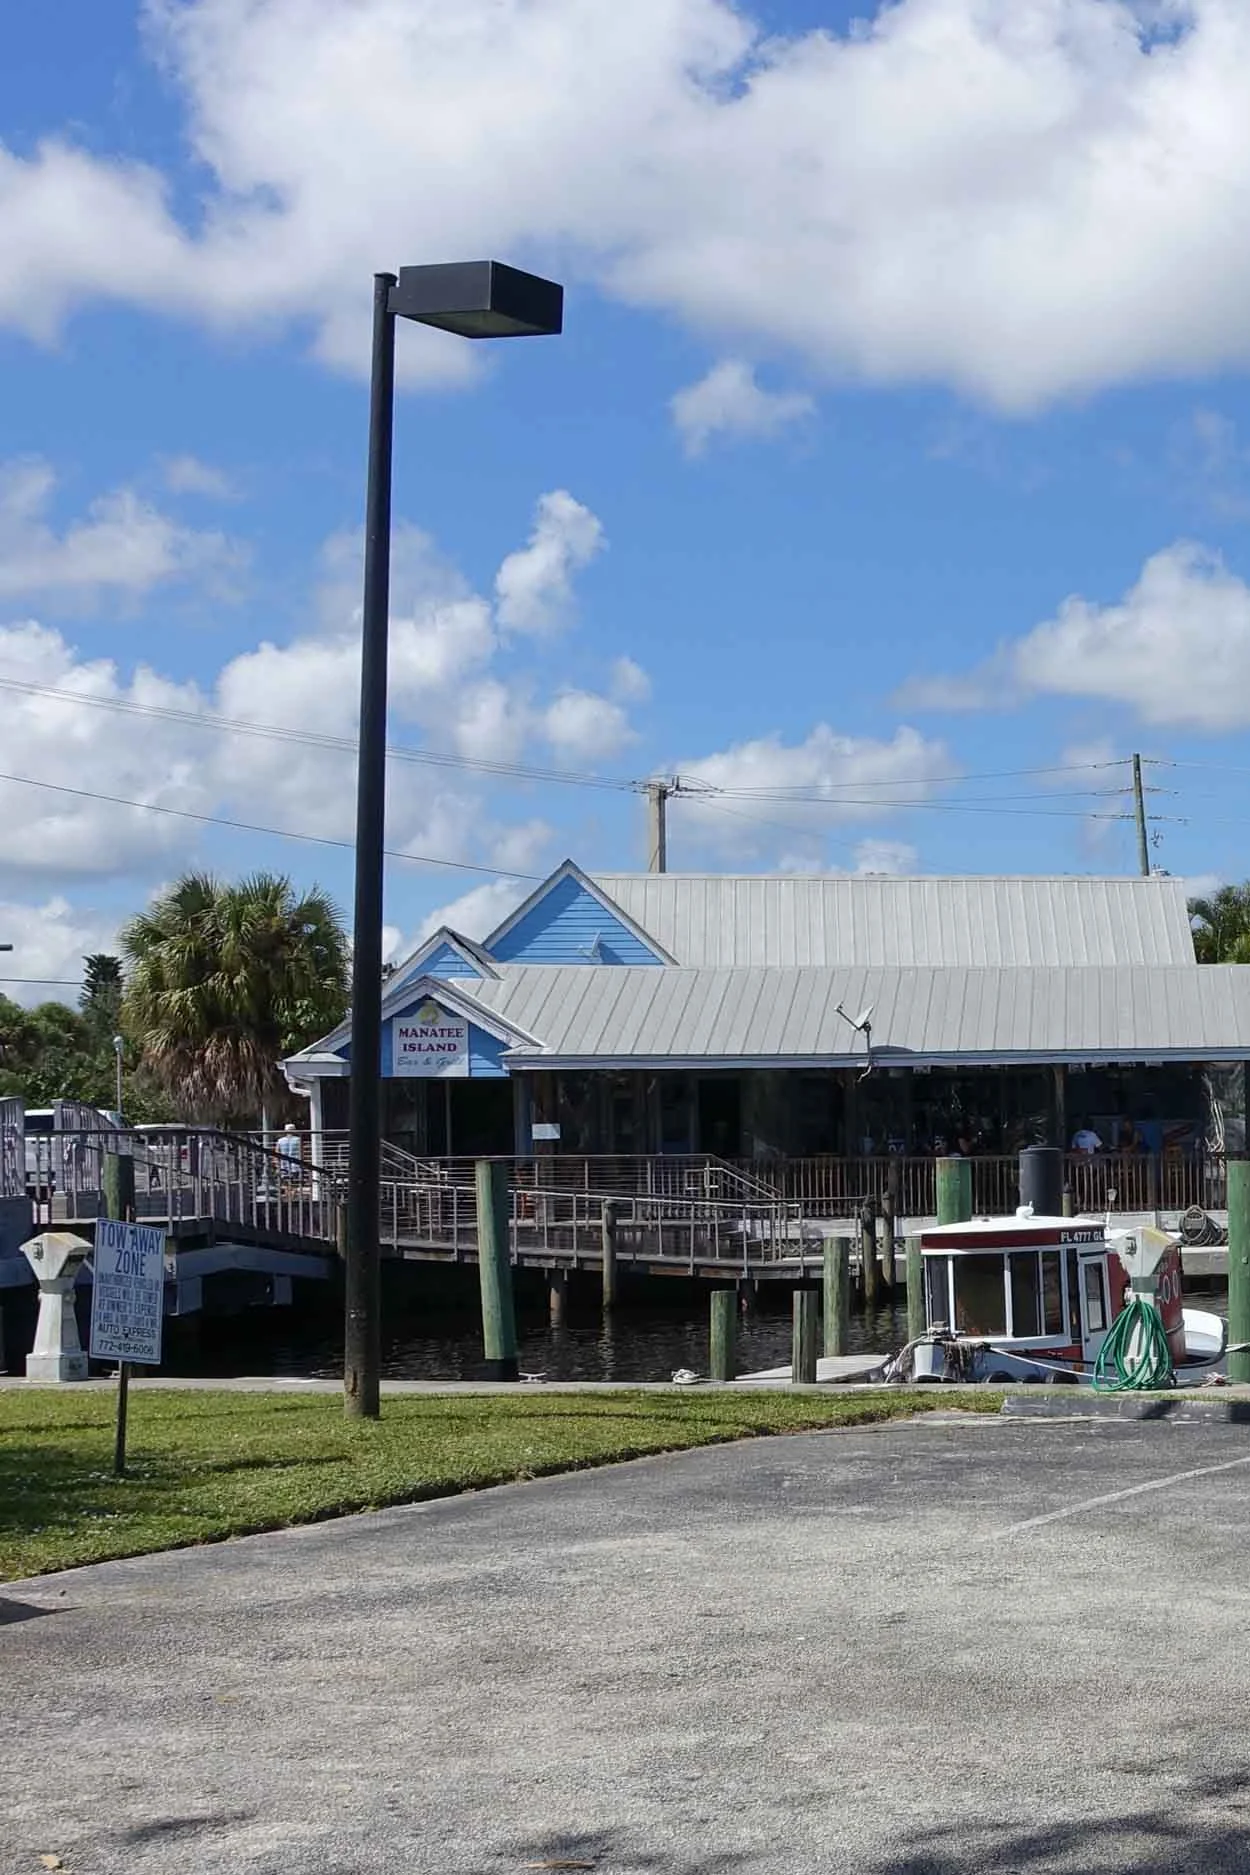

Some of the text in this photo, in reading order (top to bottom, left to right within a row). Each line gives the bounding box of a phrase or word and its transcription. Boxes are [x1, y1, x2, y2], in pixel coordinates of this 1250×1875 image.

[399, 1027, 464, 1038] MANATEE
[403, 1043, 457, 1052] ISLAND
[101, 1222, 161, 1255] TOW AWAY
[1061, 1231, 1072, 1242] FL
[115, 1250, 146, 1276] ZONE
